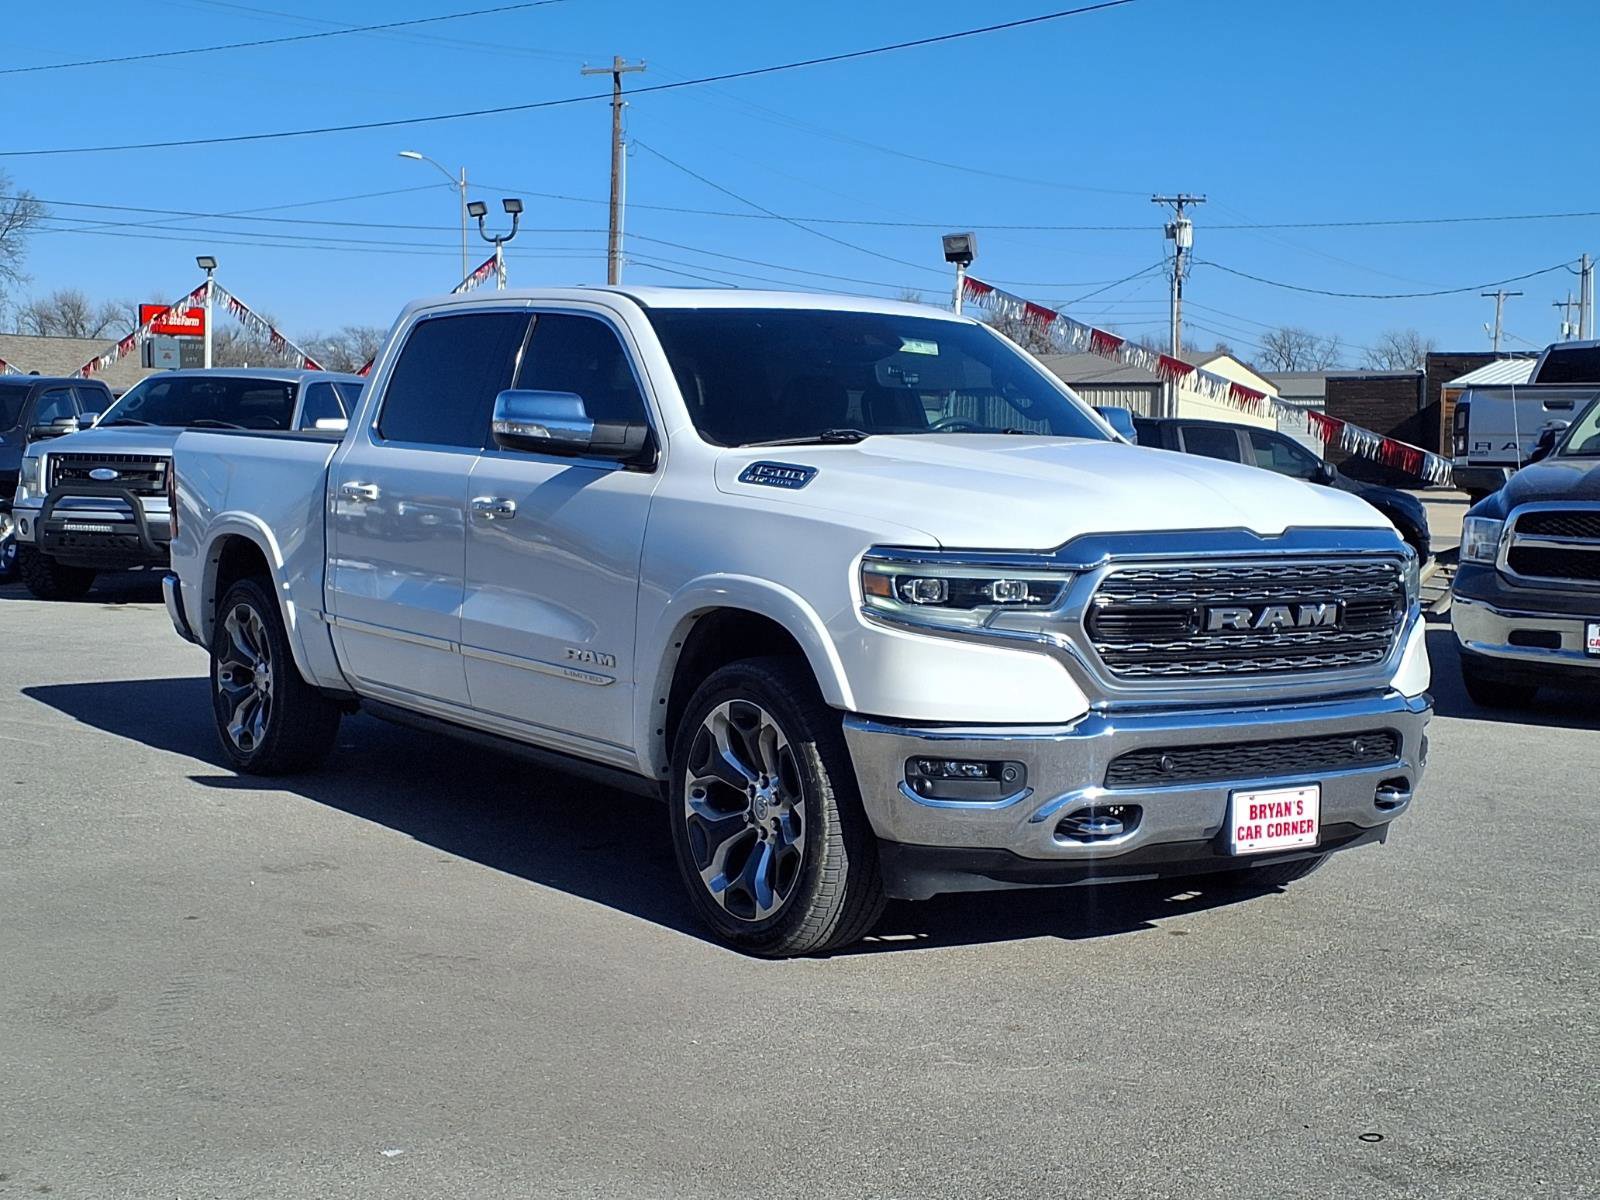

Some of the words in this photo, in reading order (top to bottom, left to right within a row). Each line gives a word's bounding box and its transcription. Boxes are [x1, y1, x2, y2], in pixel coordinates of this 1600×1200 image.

[1207, 603, 1338, 631] RAM
[565, 648, 616, 668] RAM
[1249, 800, 1304, 821] BRYAN'S
[1237, 825, 1262, 841] CAR
[1267, 819, 1314, 838] CORNER
